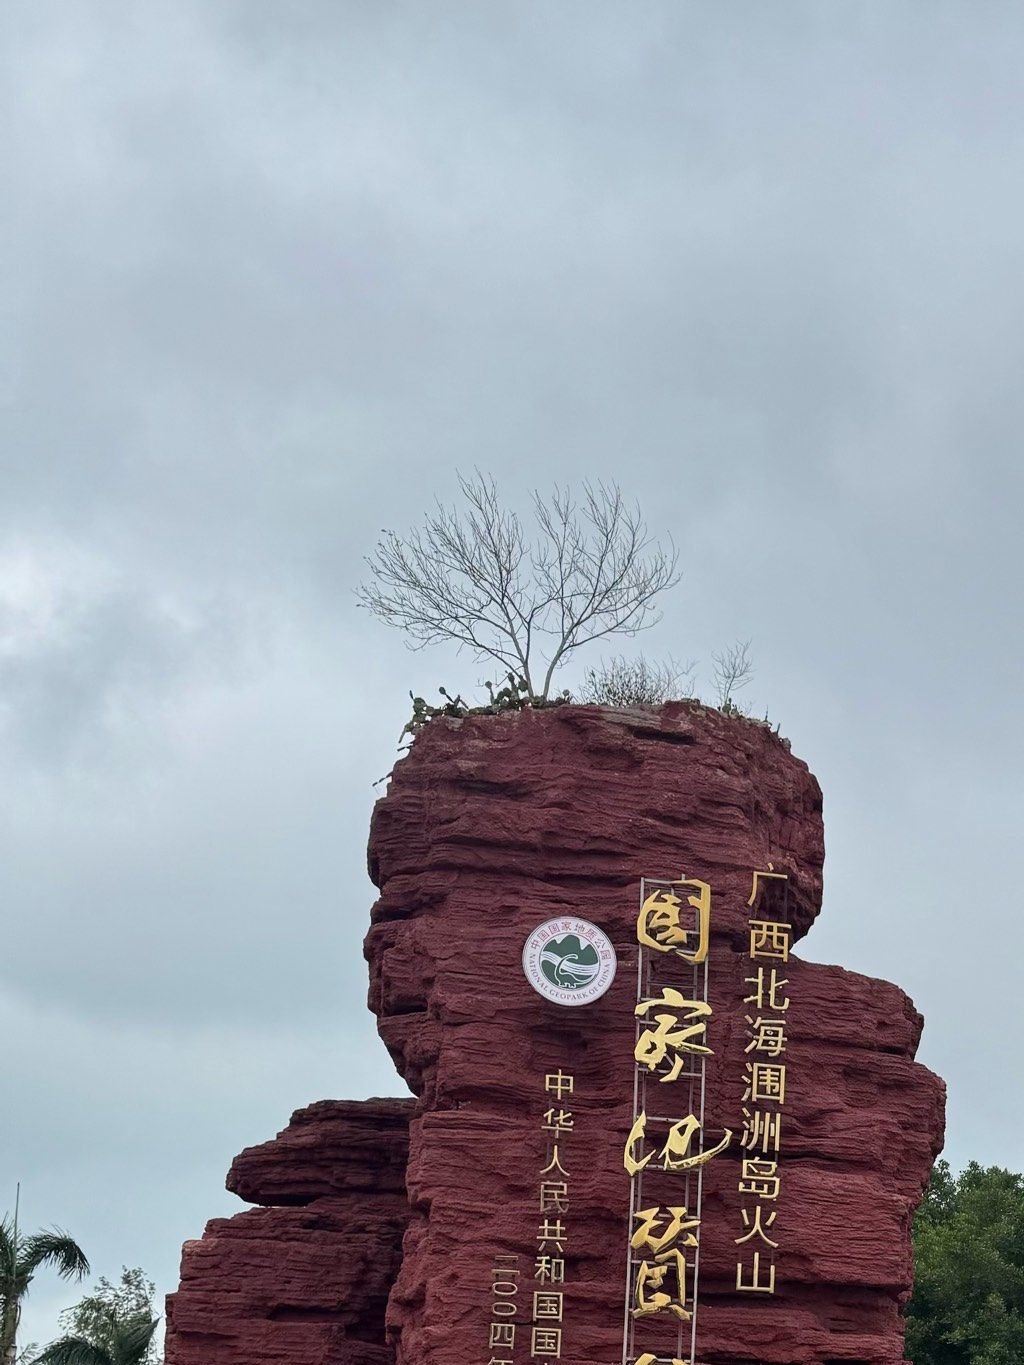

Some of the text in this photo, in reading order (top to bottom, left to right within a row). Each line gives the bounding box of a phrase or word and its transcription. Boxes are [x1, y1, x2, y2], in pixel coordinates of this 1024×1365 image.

[528, 952, 549, 992] NATIONAL
[549, 987, 589, 1001] GEOPARK
[597, 963, 611, 989] CHINA
[735, 862, 792, 1294] 广西北海涠洲岛火山
